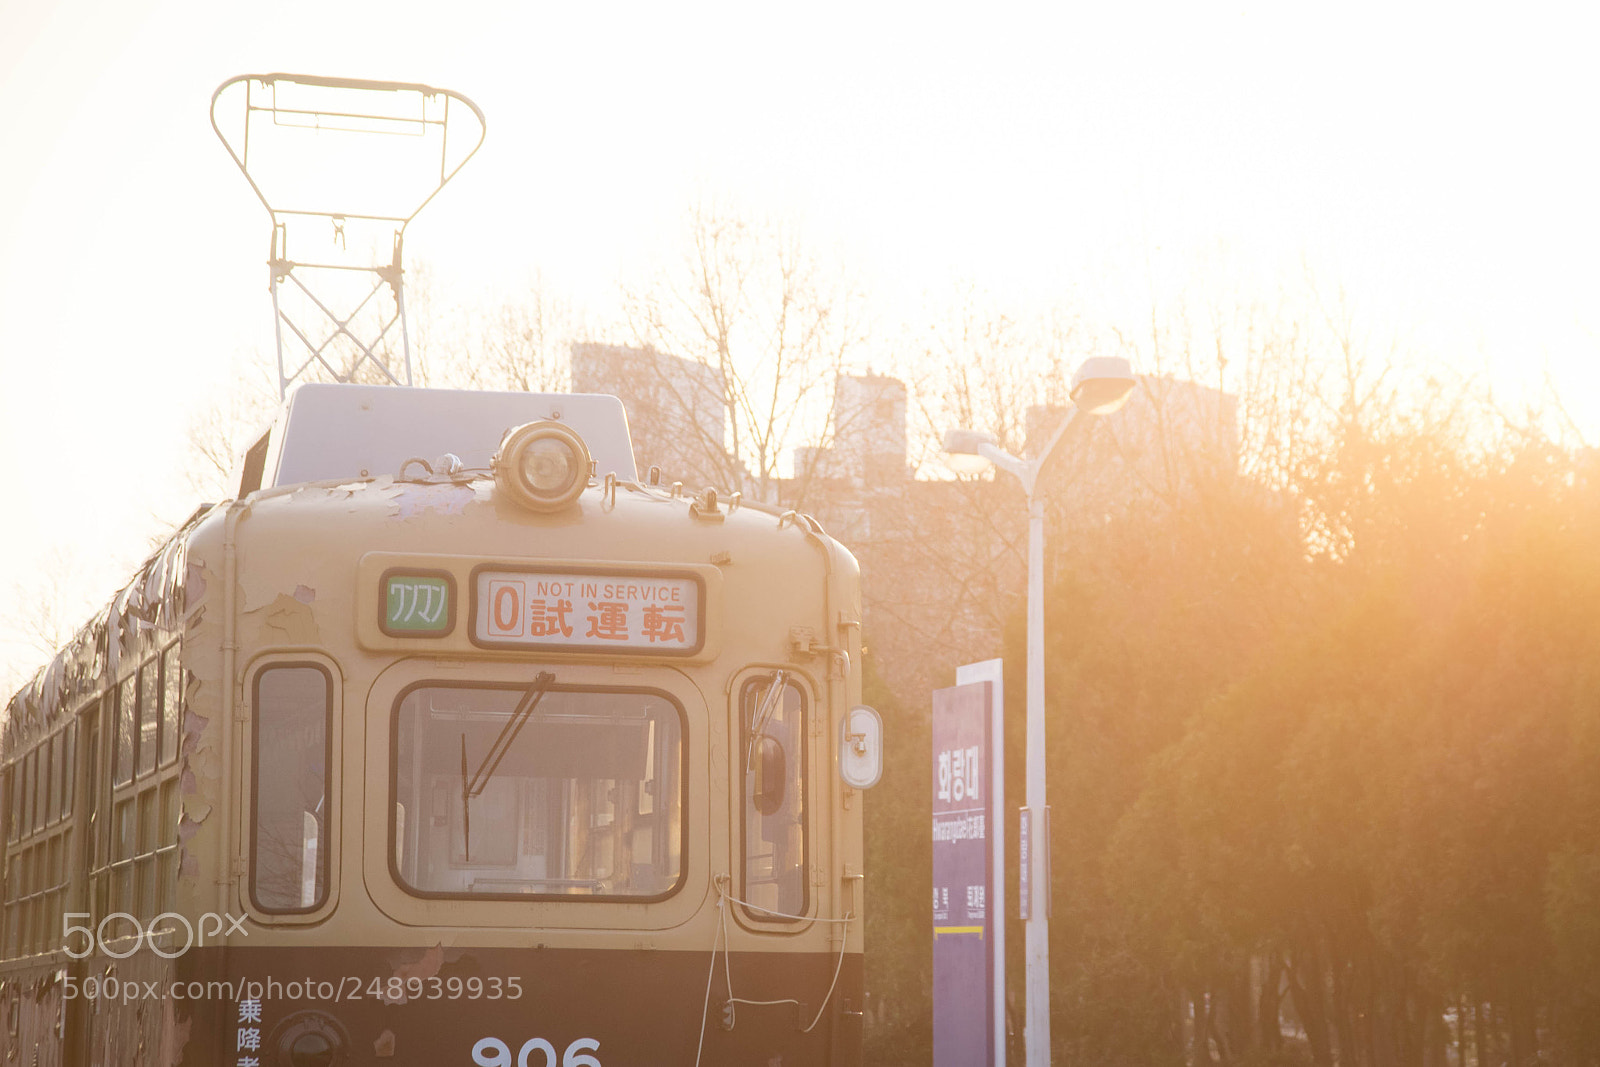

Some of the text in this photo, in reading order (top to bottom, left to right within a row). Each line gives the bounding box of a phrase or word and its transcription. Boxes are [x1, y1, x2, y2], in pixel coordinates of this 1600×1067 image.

[390, 583, 446, 623] ワンマン
[493, 585, 520, 632] 0
[537, 582, 681, 602] NOT IN SERVICE
[530, 598, 686, 643] 試運転
[471, 1037, 602, 1067] 906
